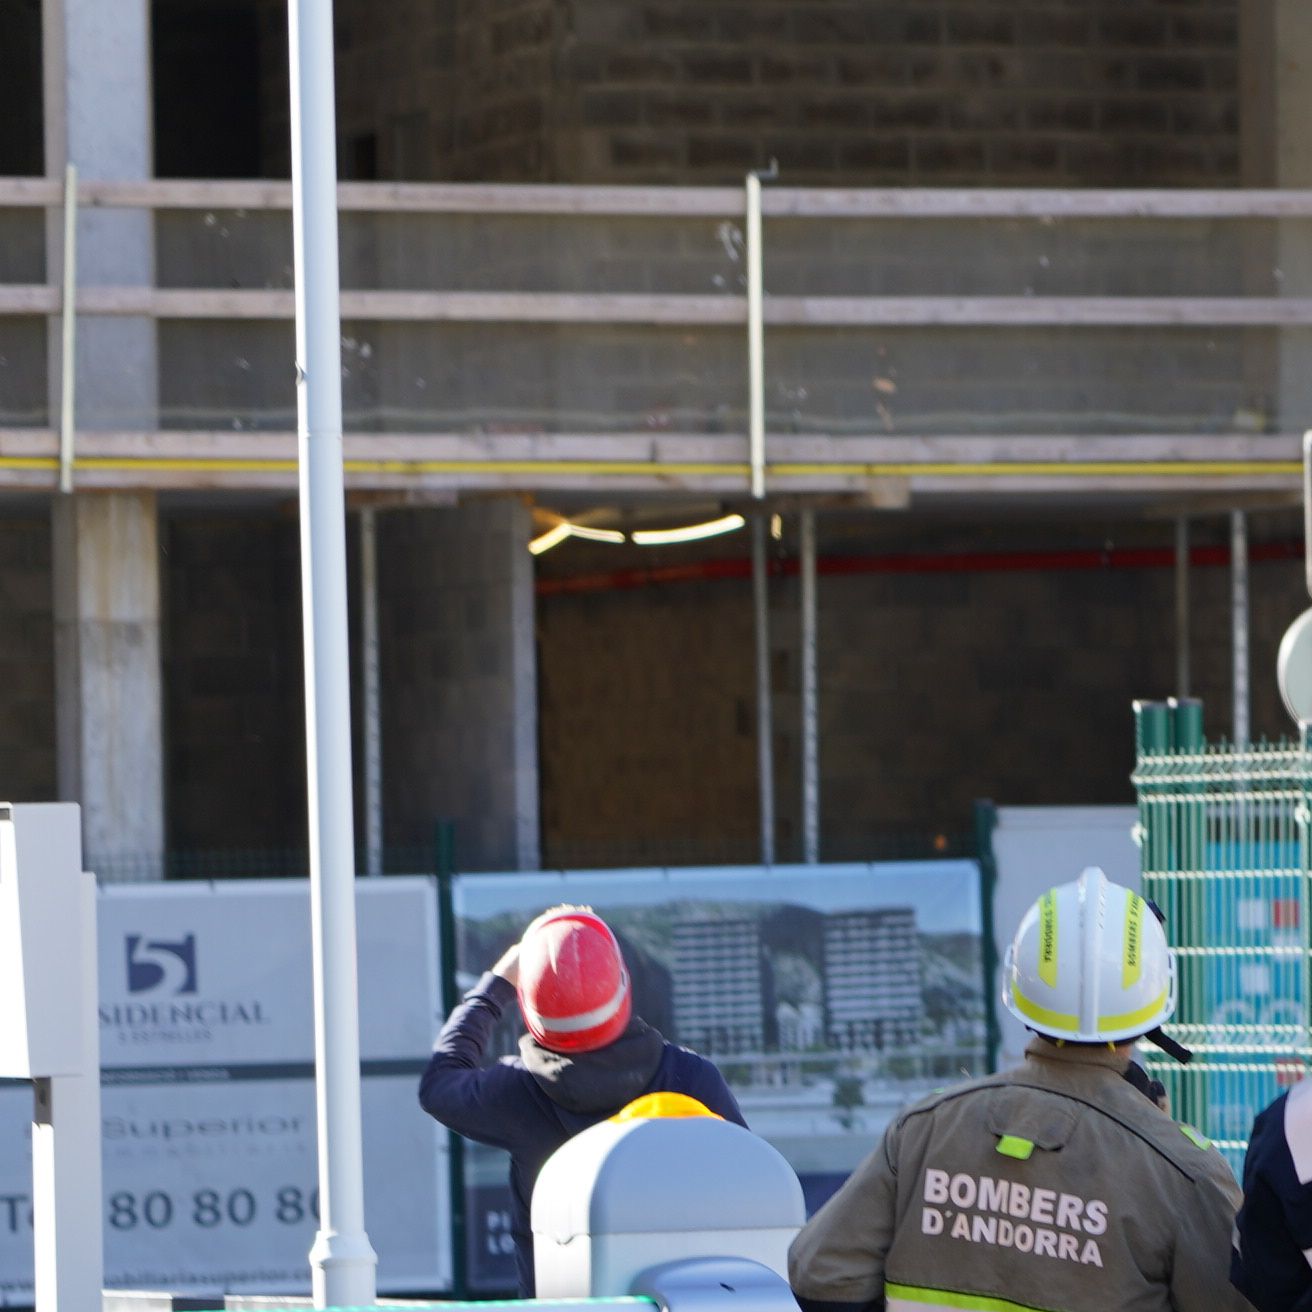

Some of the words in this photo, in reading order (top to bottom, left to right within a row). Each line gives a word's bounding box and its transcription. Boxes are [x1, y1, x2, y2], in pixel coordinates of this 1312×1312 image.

[98, 1001, 269, 1026] SIDENCIAL
[109, 1192, 172, 1228] 80
[192, 1188, 256, 1226] 80
[923, 1168, 1109, 1235] BOMBERS
